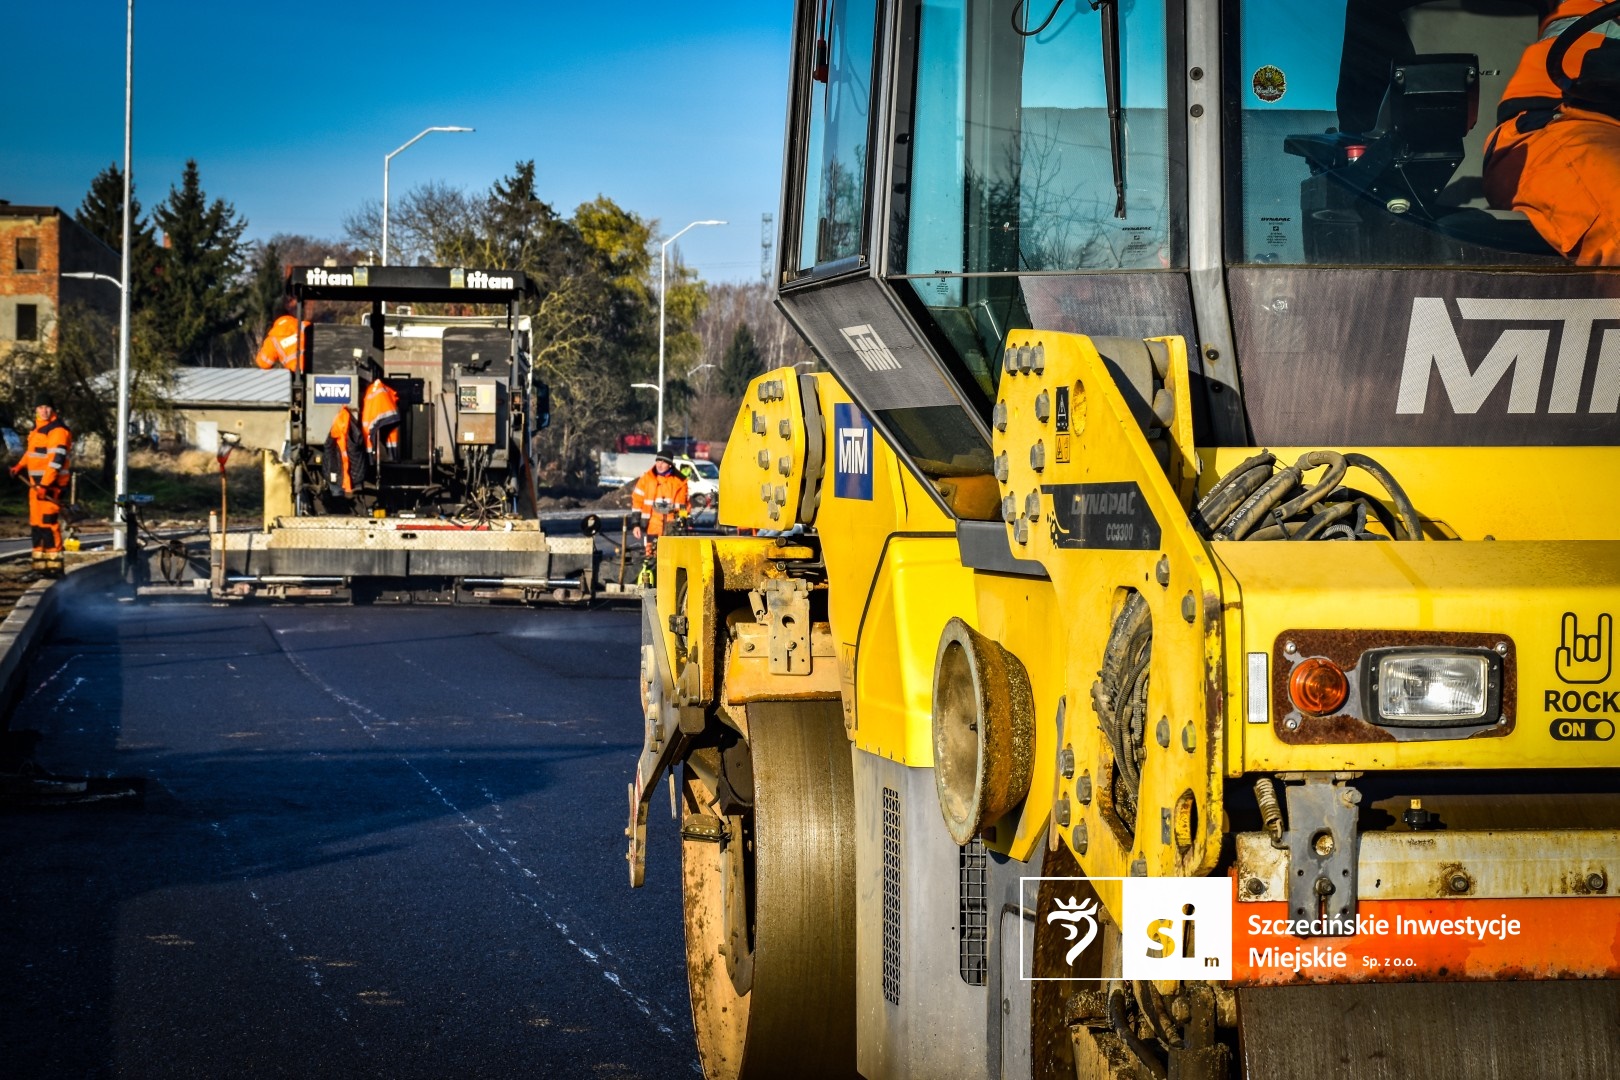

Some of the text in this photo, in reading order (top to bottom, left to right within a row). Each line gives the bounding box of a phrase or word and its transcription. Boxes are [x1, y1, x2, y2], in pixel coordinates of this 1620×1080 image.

[306, 267, 353, 286] titan
[467, 271, 513, 289] titan
[839, 324, 902, 371] MTM
[1396, 297, 1620, 414] MT
[315, 383, 350, 398] MTM
[839, 428, 868, 475] MTM
[1071, 491, 1137, 515] DYNAPAC
[1106, 523, 1133, 541] CC3300
[1544, 690, 1620, 713] ROCK
[1558, 721, 1586, 738] ON
